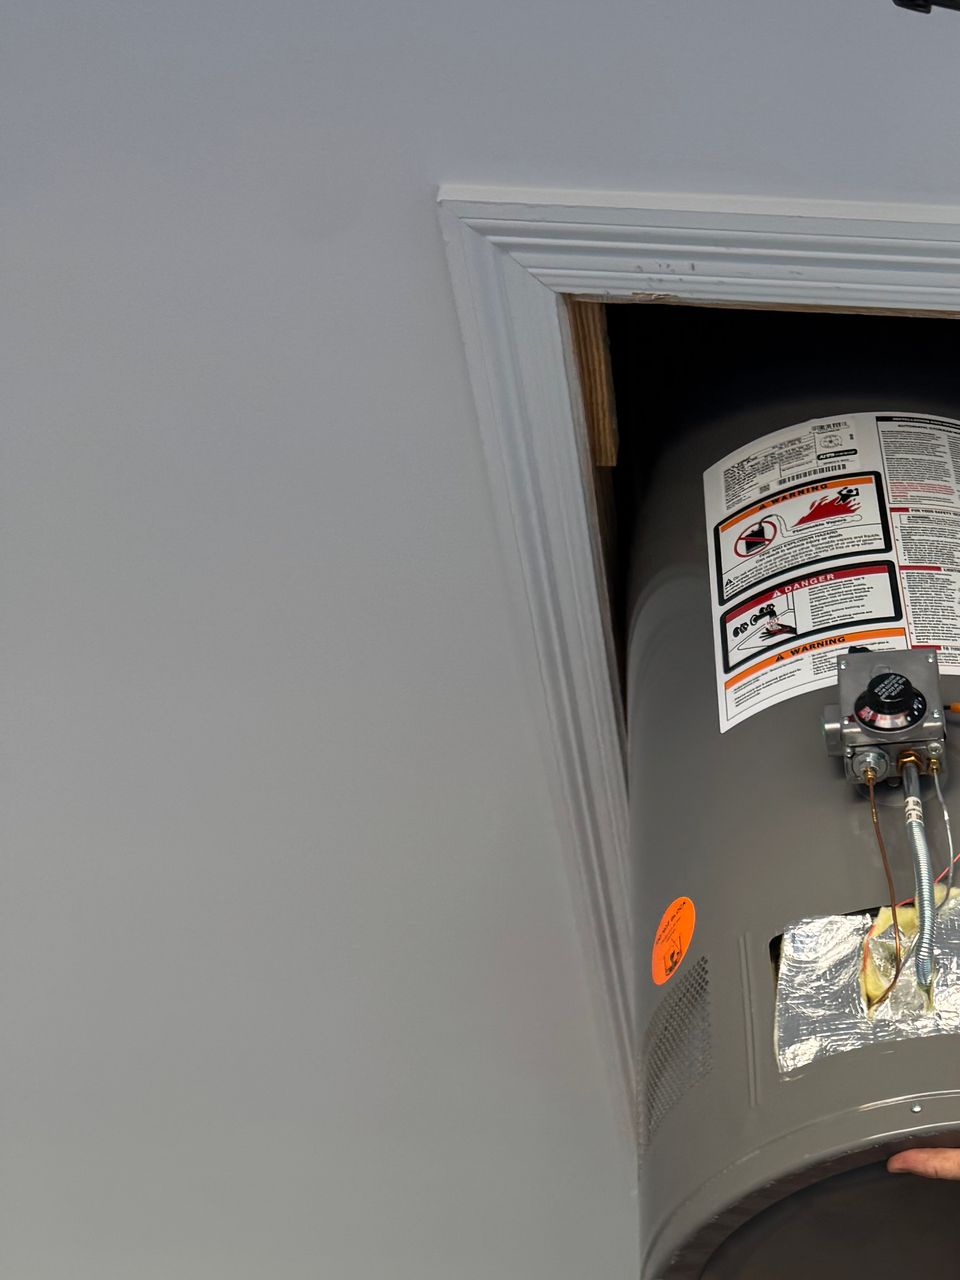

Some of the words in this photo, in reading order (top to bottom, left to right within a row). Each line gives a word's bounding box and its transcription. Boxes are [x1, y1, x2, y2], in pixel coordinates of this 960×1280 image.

[771, 484, 828, 504] WARNING
[784, 573, 835, 593] DANGER
[790, 636, 846, 656] WARNING
